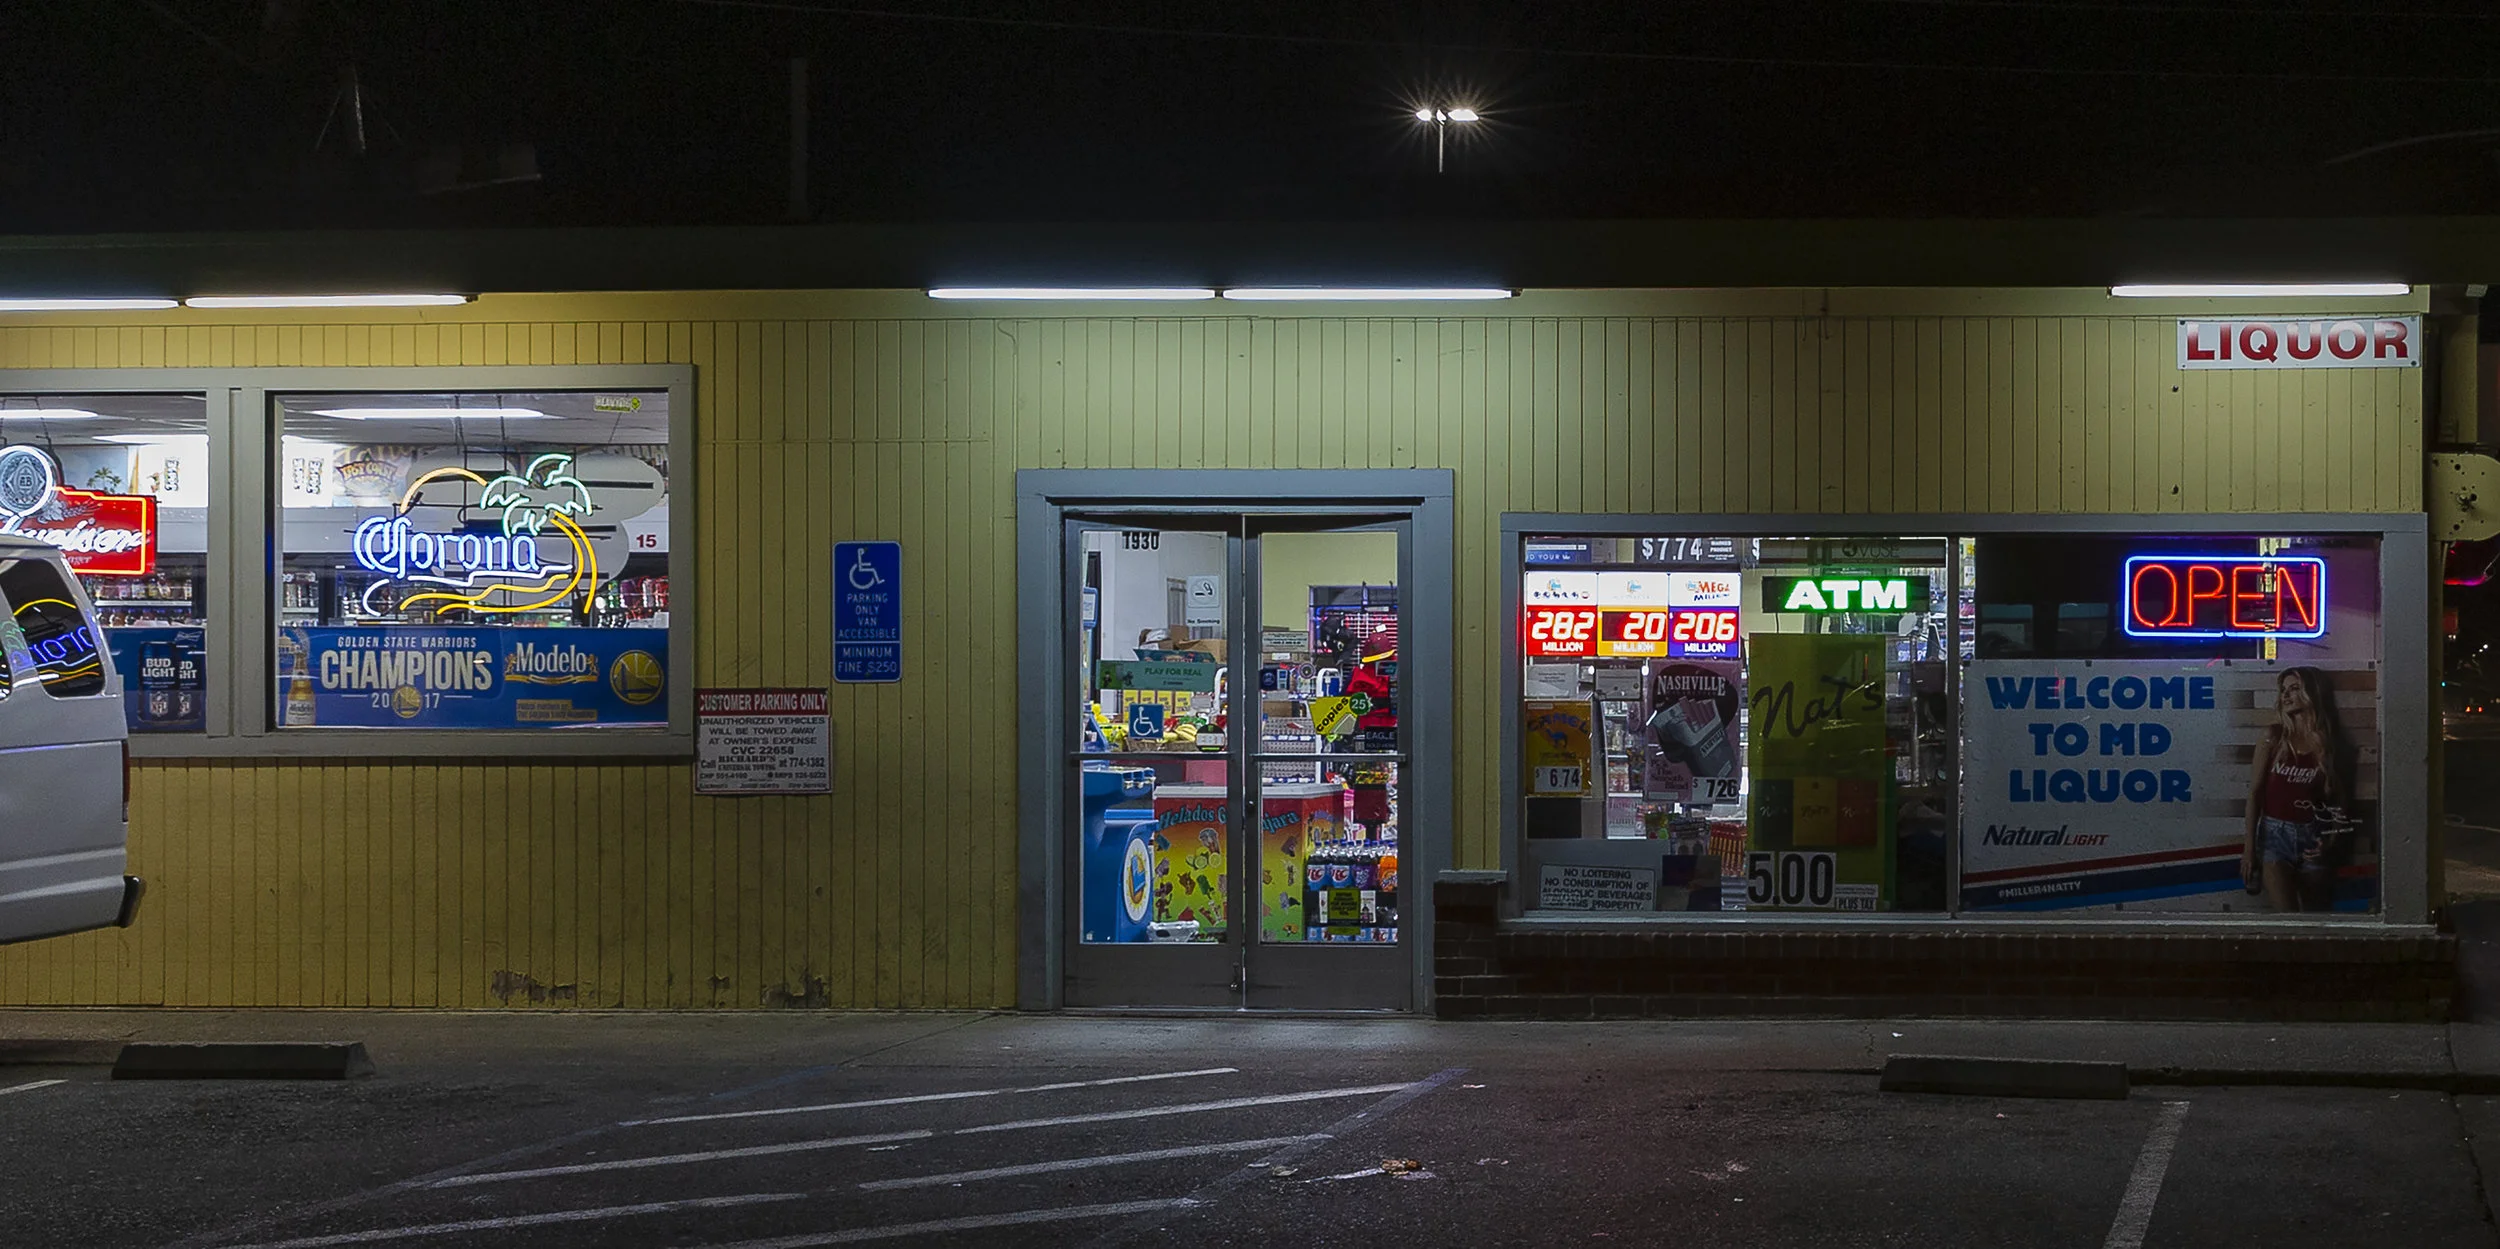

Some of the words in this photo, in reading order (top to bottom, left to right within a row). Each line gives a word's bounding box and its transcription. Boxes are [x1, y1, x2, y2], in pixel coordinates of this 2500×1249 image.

[2187, 321, 2408, 363] LIQUOR
[353, 517, 539, 578] Corona
[636, 534, 657, 548] 15
[1642, 537, 1703, 561] $7.74
[846, 593, 889, 603] PARKING
[1785, 580, 1908, 610] ATM
[2133, 564, 2317, 628] OPEN
[855, 605, 880, 615] ONLY
[857, 617, 877, 626] VAN
[1531, 611, 1596, 641] 282
[1623, 612, 1666, 641] 20
[1673, 612, 1736, 641] 206
[337, 637, 379, 648] GOLDEN
[384, 637, 417, 648] STATE
[421, 636, 477, 648] WARRIORS
[838, 628, 897, 639] ACCESSIBLE
[842, 647, 893, 657] MINIMUM
[1541, 641, 1584, 653] MILLION
[1684, 642, 1726, 654] MILLION
[145, 658, 171, 668] BUD
[516, 642, 586, 673] Modelo
[142, 668, 175, 678] LIGHT
[320, 650, 492, 691] CHAMPIONS
[837, 661, 862, 672] FINE
[867, 661, 897, 673] $250
[1145, 667, 1163, 675] PLAY
[1165, 667, 1181, 675] FOR
[1183, 667, 1202, 676] REAL
[1657, 675, 1727, 696] NASHVILLE
[1986, 676, 2215, 710] WELCOME
[700, 694, 751, 711] CUSTOMER
[754, 694, 797, 711] PARKING
[800, 694, 827, 710] ONLY
[1351, 698, 1366, 709] 25
[1752, 675, 1883, 739] Nat's
[700, 717, 774, 725] UNAUTHORIZED
[778, 717, 825, 725] VEHICLES
[1316, 696, 1349, 732] copies
[1527, 713, 1589, 733] CAMEL
[2029, 722, 2089, 756] TO
[2100, 723, 2172, 756] MD
[731, 746, 756, 755] CVC
[759, 746, 794, 755] 22658
[701, 759, 717, 769] Call
[2271, 760, 2319, 777] Natural
[1549, 769, 1580, 787] 6.74
[2010, 769, 2192, 803] LIQUOR
[1157, 805, 1215, 831] Helados
[1983, 824, 2068, 846] Natural
[2065, 834, 2110, 846] LIGHT
[1564, 868, 1578, 876] NO
[1582, 869, 1631, 879] LOITERING
[1747, 853, 1834, 906] 5.00
[1544, 878, 1559, 886] NO
[1563, 878, 1632, 889] CONSUMPTION
[1636, 882, 1649, 890] OF
[1598, 890, 1652, 900] BEVERAGES
[1838, 898, 1858, 910] PLUS
[1860, 898, 1874, 910] TAX
